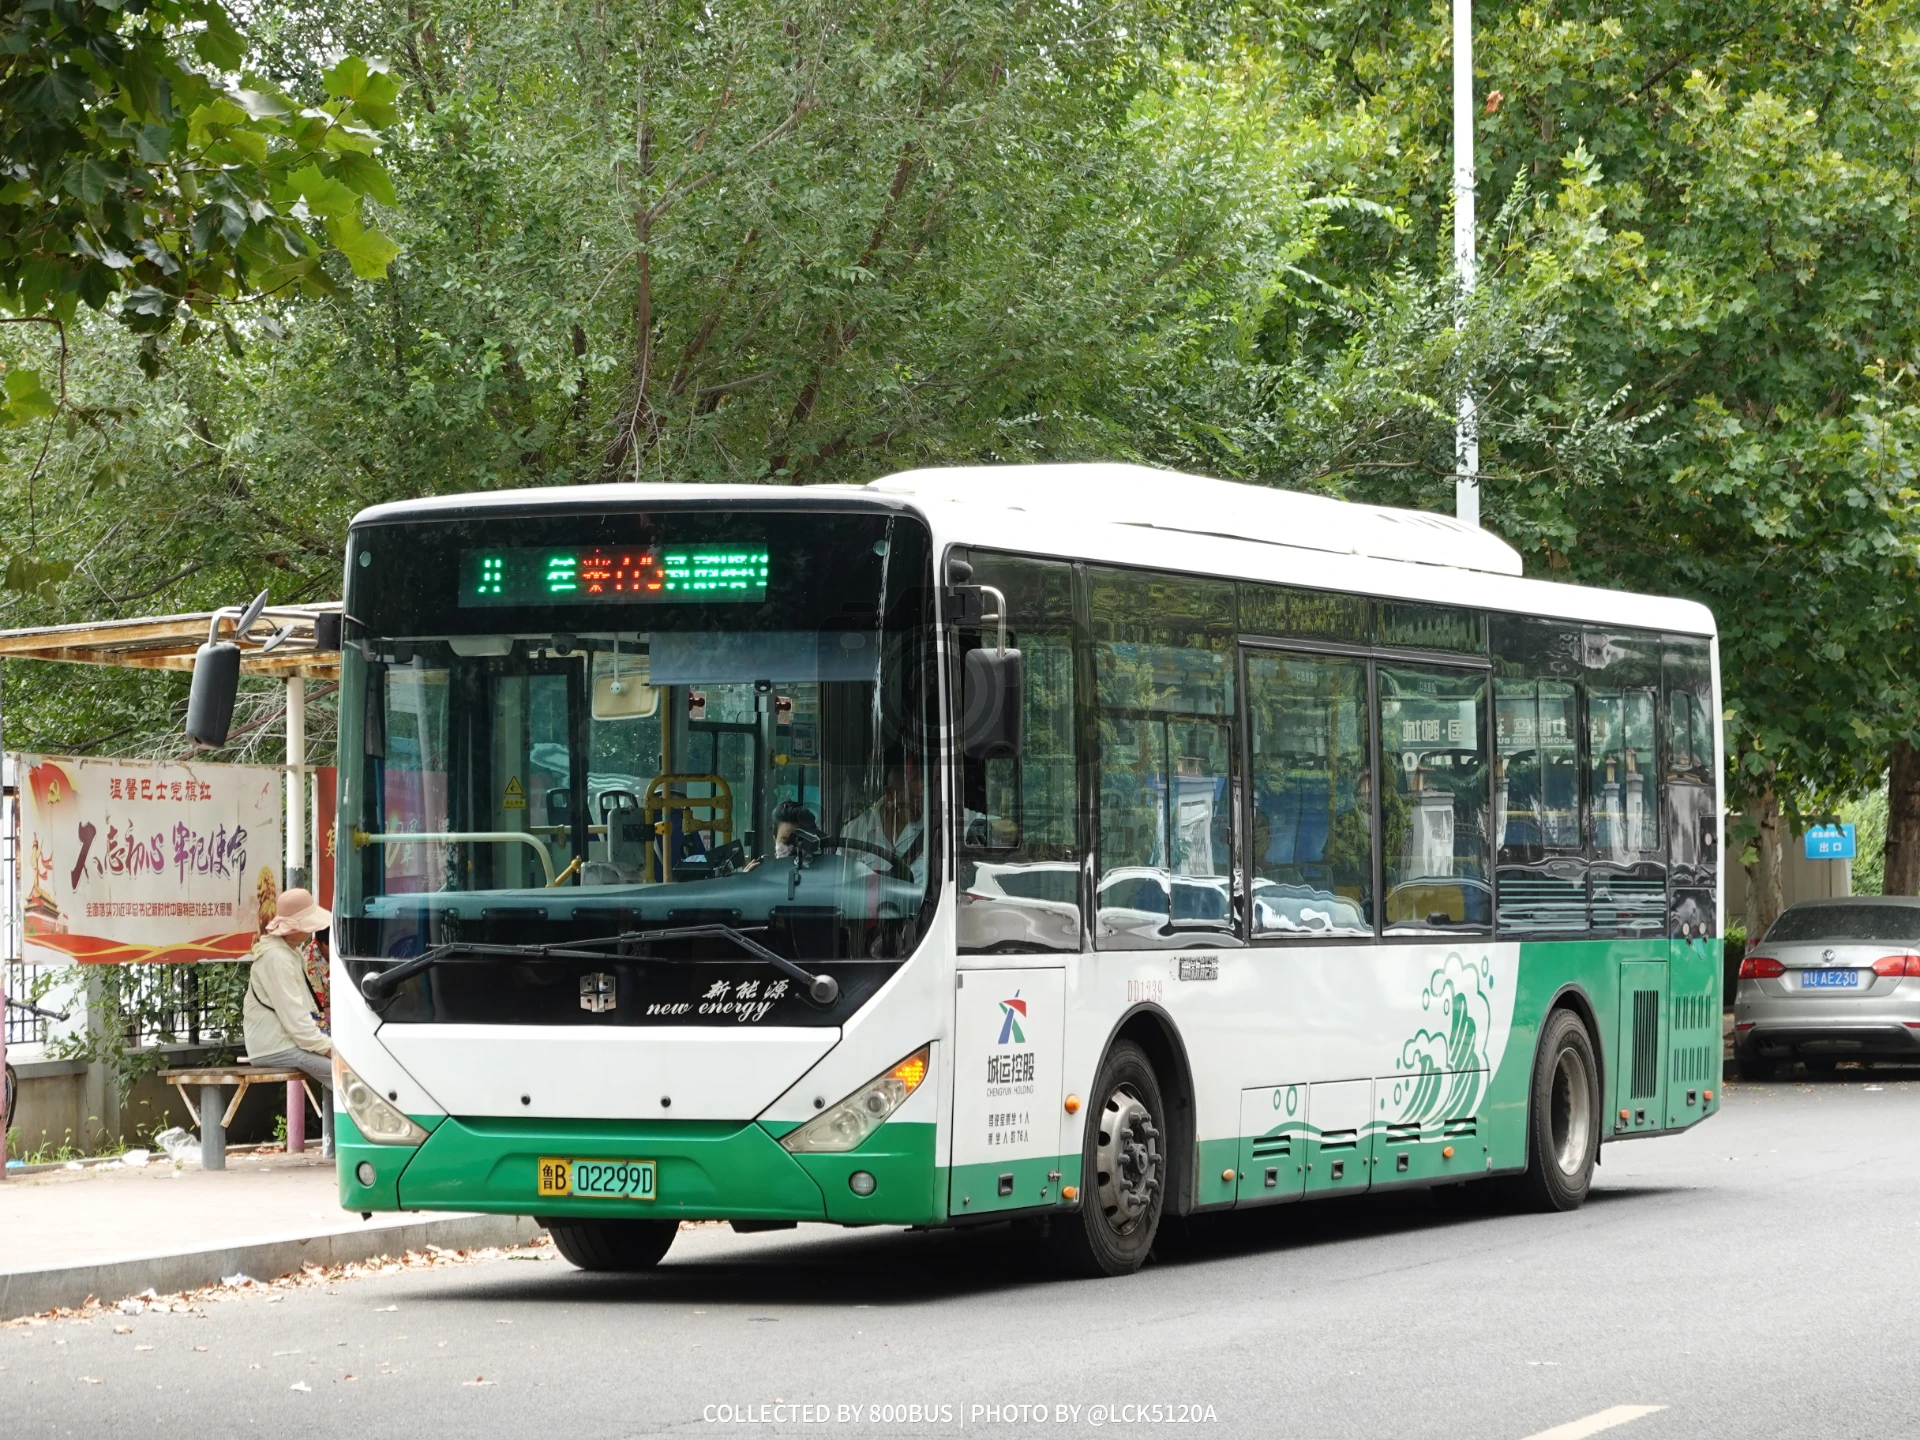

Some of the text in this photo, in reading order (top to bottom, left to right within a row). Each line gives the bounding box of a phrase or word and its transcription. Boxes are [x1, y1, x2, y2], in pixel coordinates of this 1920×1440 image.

[109, 778, 212, 802] 温馨巴士党旗红
[1819, 842, 1842, 853] 出口
[70, 818, 164, 890] 不忘初心
[172, 820, 248, 905] 牢记使命
[86, 902, 233, 918] 全面落实习近平总书记新时代中国特色社会主义思想
[702, 978, 790, 1000] 新能源
[646, 1000, 776, 1022] new energy
[987, 1052, 1035, 1085] 城运控股
[986, 1084, 1034, 1098] CHENGYUN HOLDING
